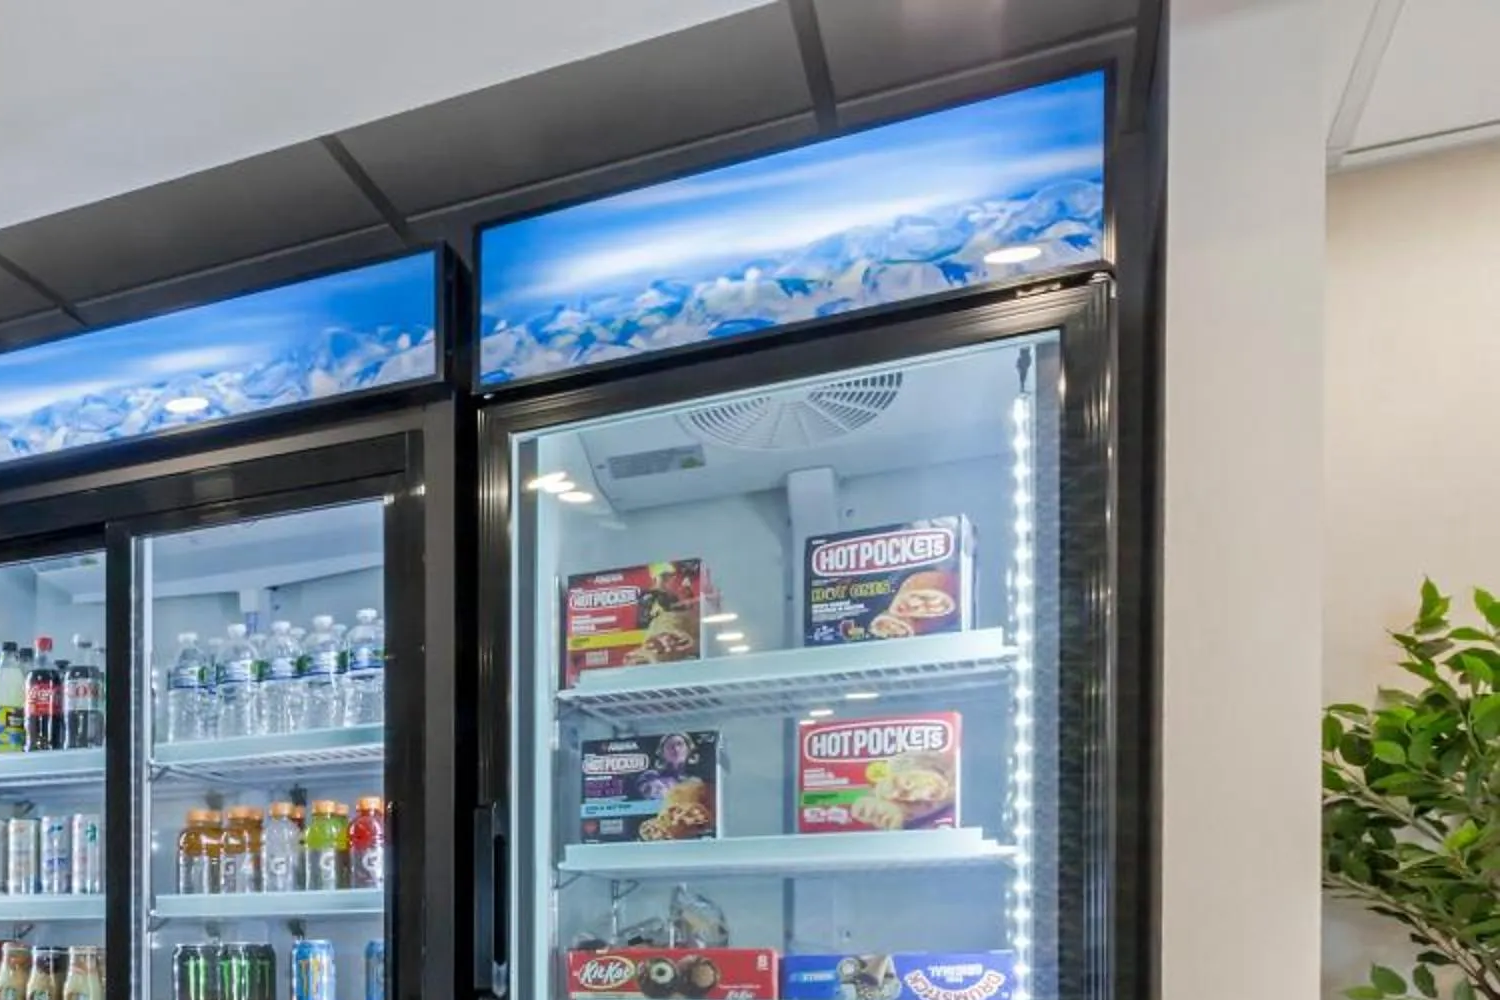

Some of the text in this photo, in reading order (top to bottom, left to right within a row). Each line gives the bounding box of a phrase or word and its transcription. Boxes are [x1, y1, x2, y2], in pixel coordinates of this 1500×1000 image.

[819, 533, 946, 571] HOT POCKETS
[811, 725, 943, 757] HOT POCKETS
